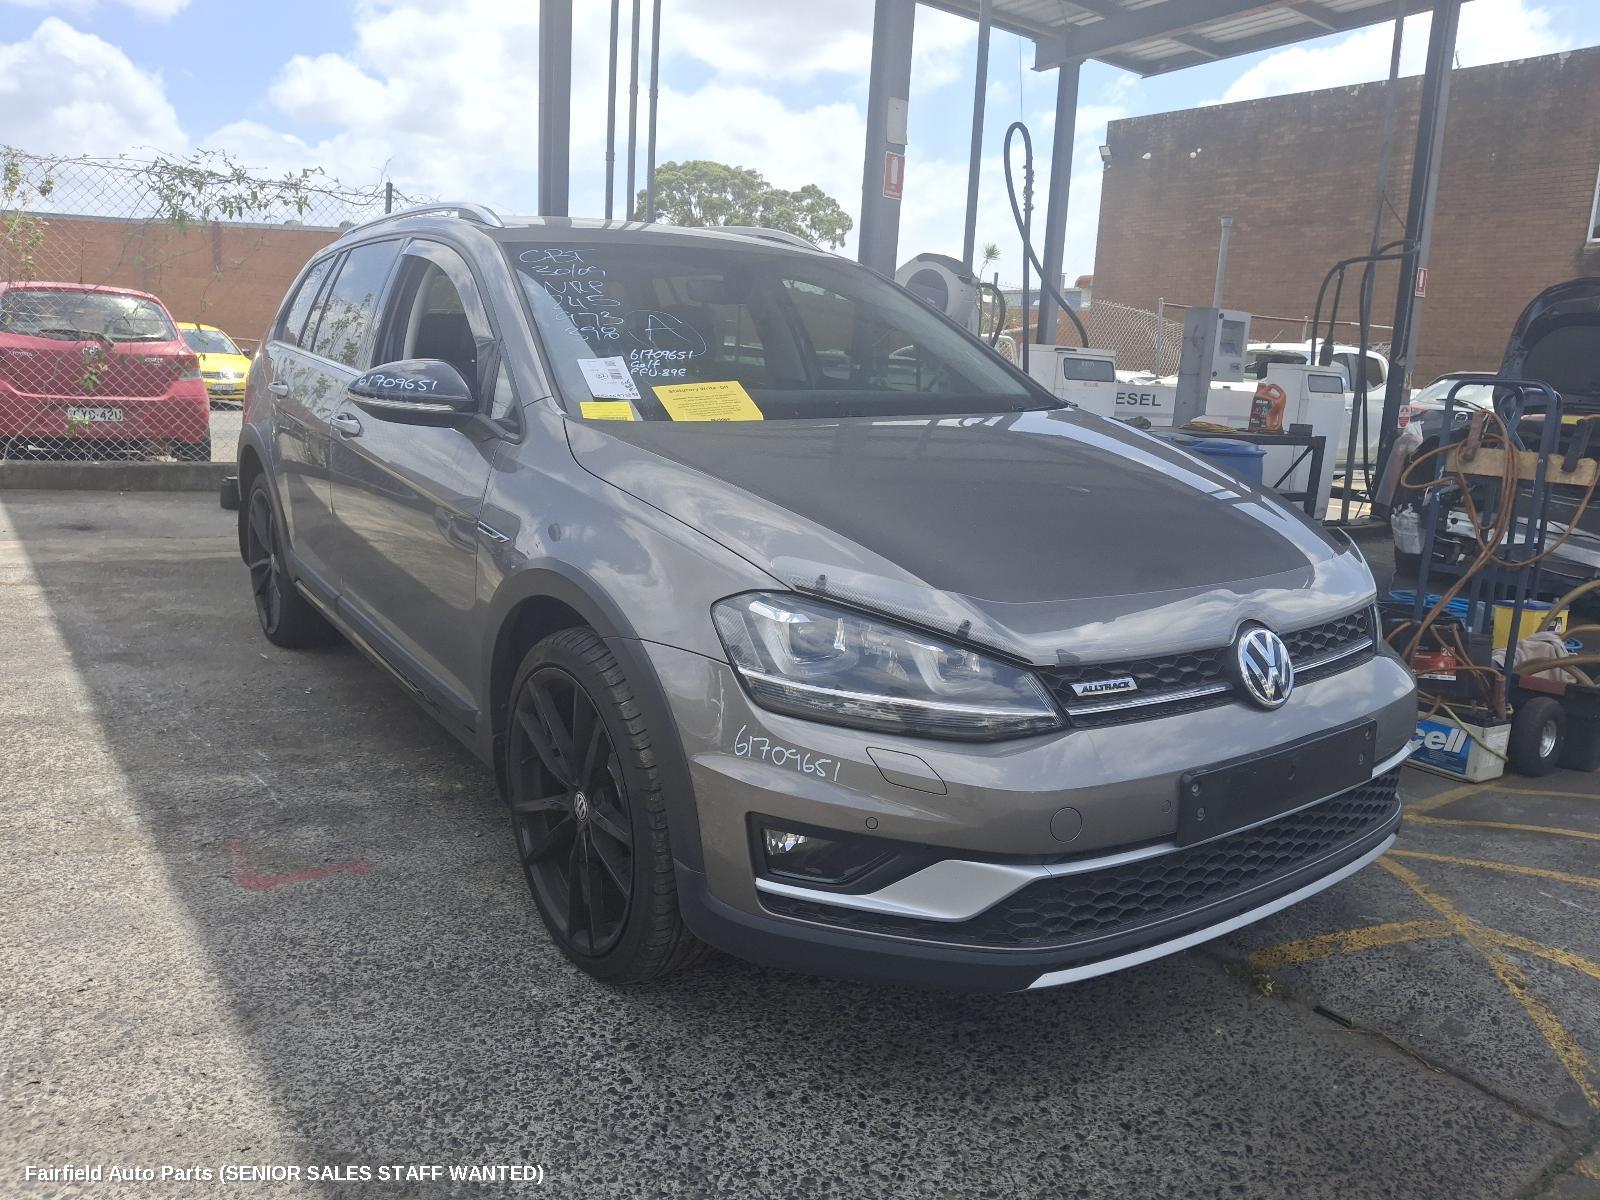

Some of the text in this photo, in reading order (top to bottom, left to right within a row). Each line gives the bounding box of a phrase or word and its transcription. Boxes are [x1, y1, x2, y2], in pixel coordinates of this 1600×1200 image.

[630, 348, 694, 361] 61709651
[630, 359, 661, 369] Golf
[358, 374, 438, 391] 61709651
[1115, 392, 1162, 407] ESEL
[1081, 680, 1131, 694] ALLTRACK
[733, 724, 841, 782] 61709651
